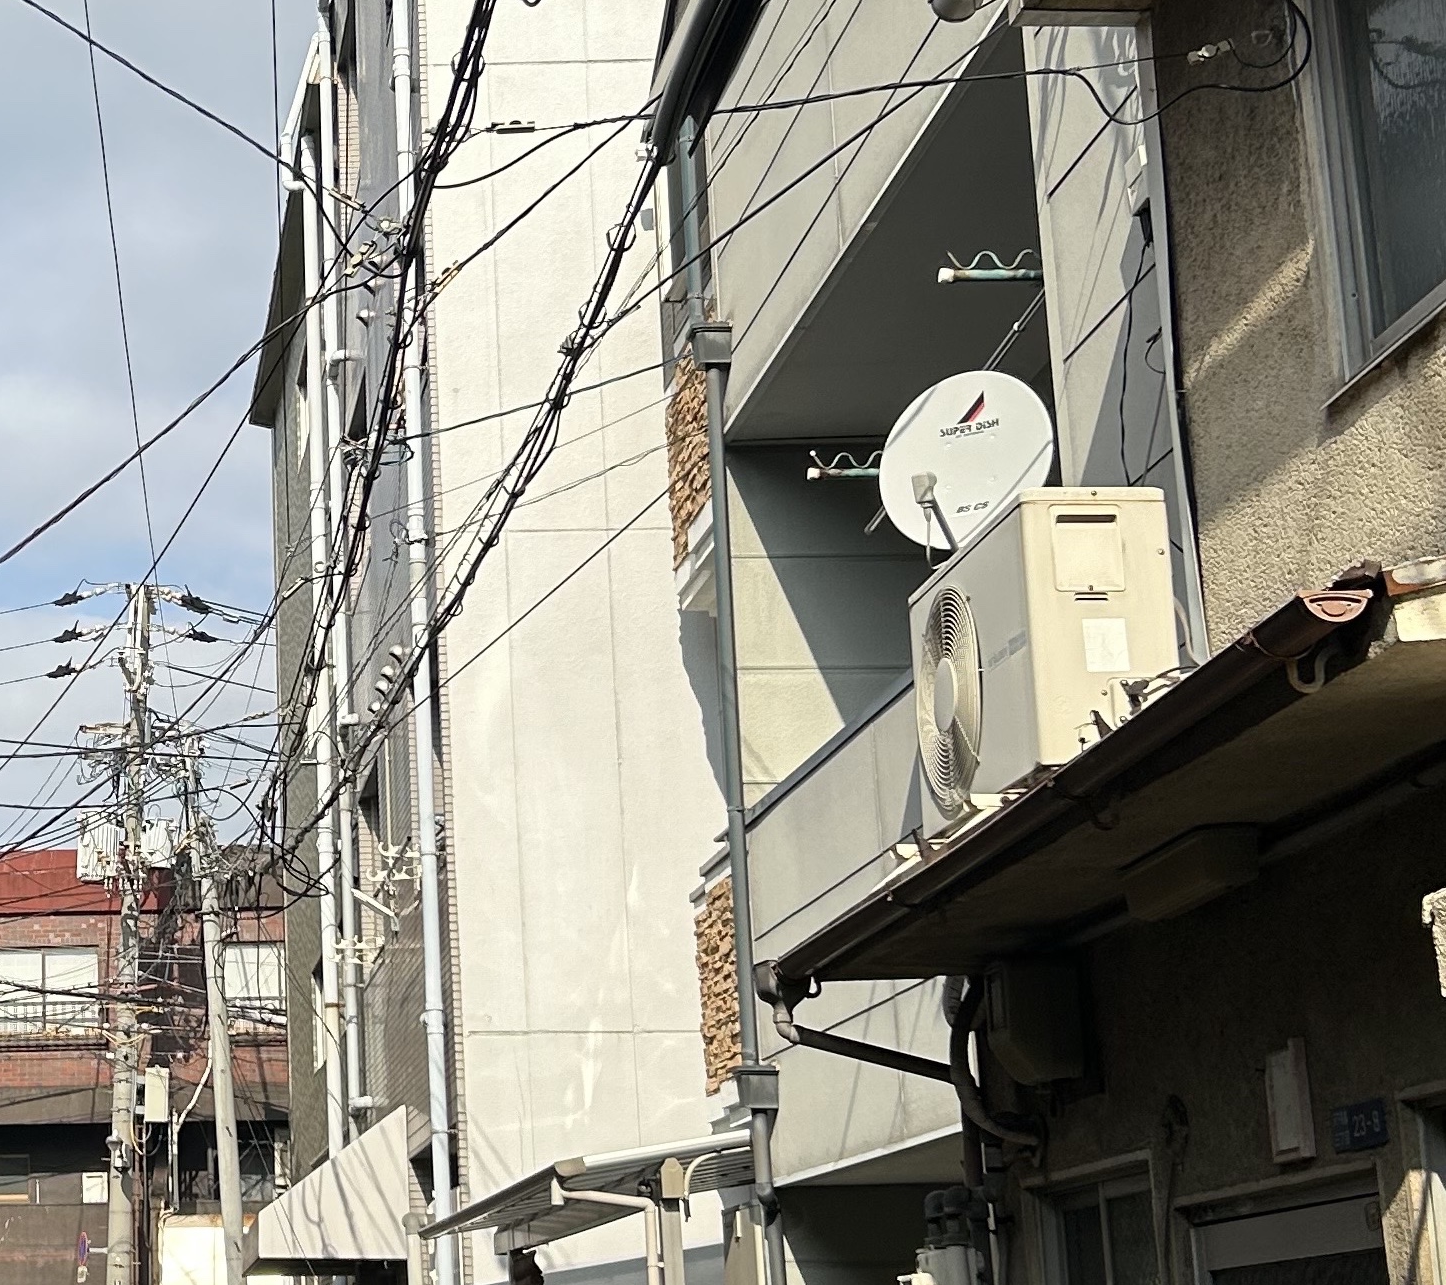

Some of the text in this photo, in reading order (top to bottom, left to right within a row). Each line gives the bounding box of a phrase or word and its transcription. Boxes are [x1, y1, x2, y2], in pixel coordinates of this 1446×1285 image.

[939, 425, 972, 438] SUPER
[975, 418, 1000, 431] DISH
[956, 501, 990, 513] BS CS
